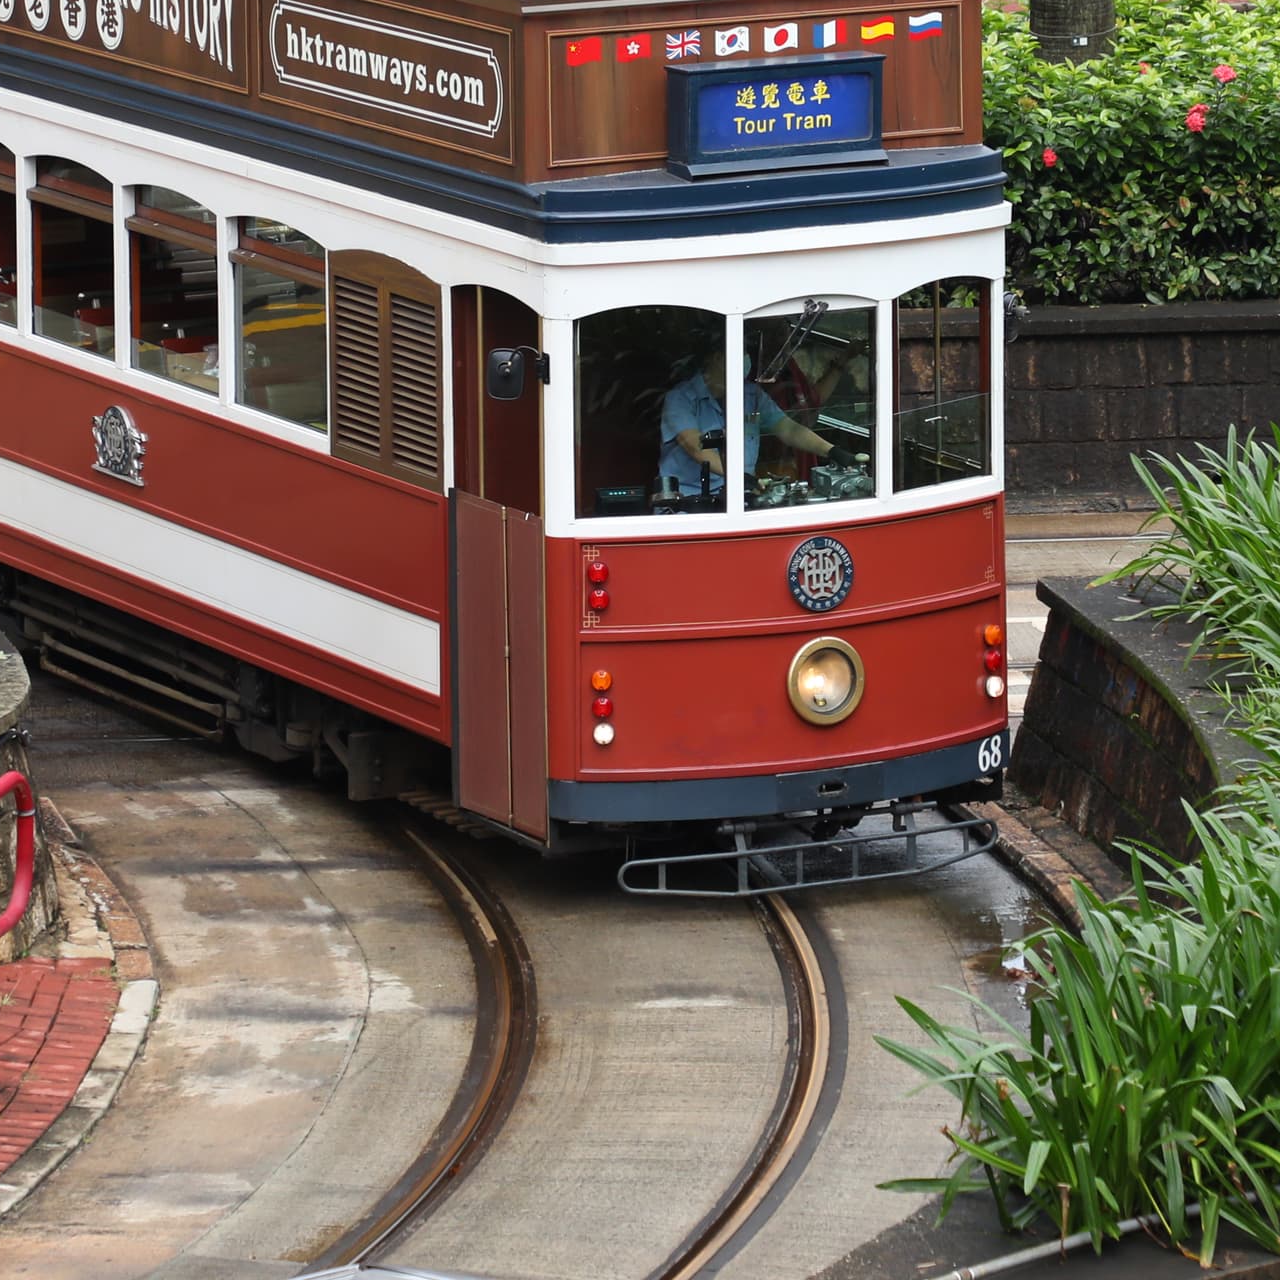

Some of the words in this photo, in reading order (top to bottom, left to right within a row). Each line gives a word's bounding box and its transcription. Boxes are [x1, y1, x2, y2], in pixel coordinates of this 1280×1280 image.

[286, 23, 485, 107] hktramways.com
[735, 79, 831, 109] 遊覽電車
[733, 117, 776, 135] Tour
[783, 113, 832, 131] Tram
[790, 553, 802, 573] HONG
[800, 540, 816, 555] KONG
[824, 538, 852, 567] TRAMWAYS
[978, 734, 1002, 772] 68
